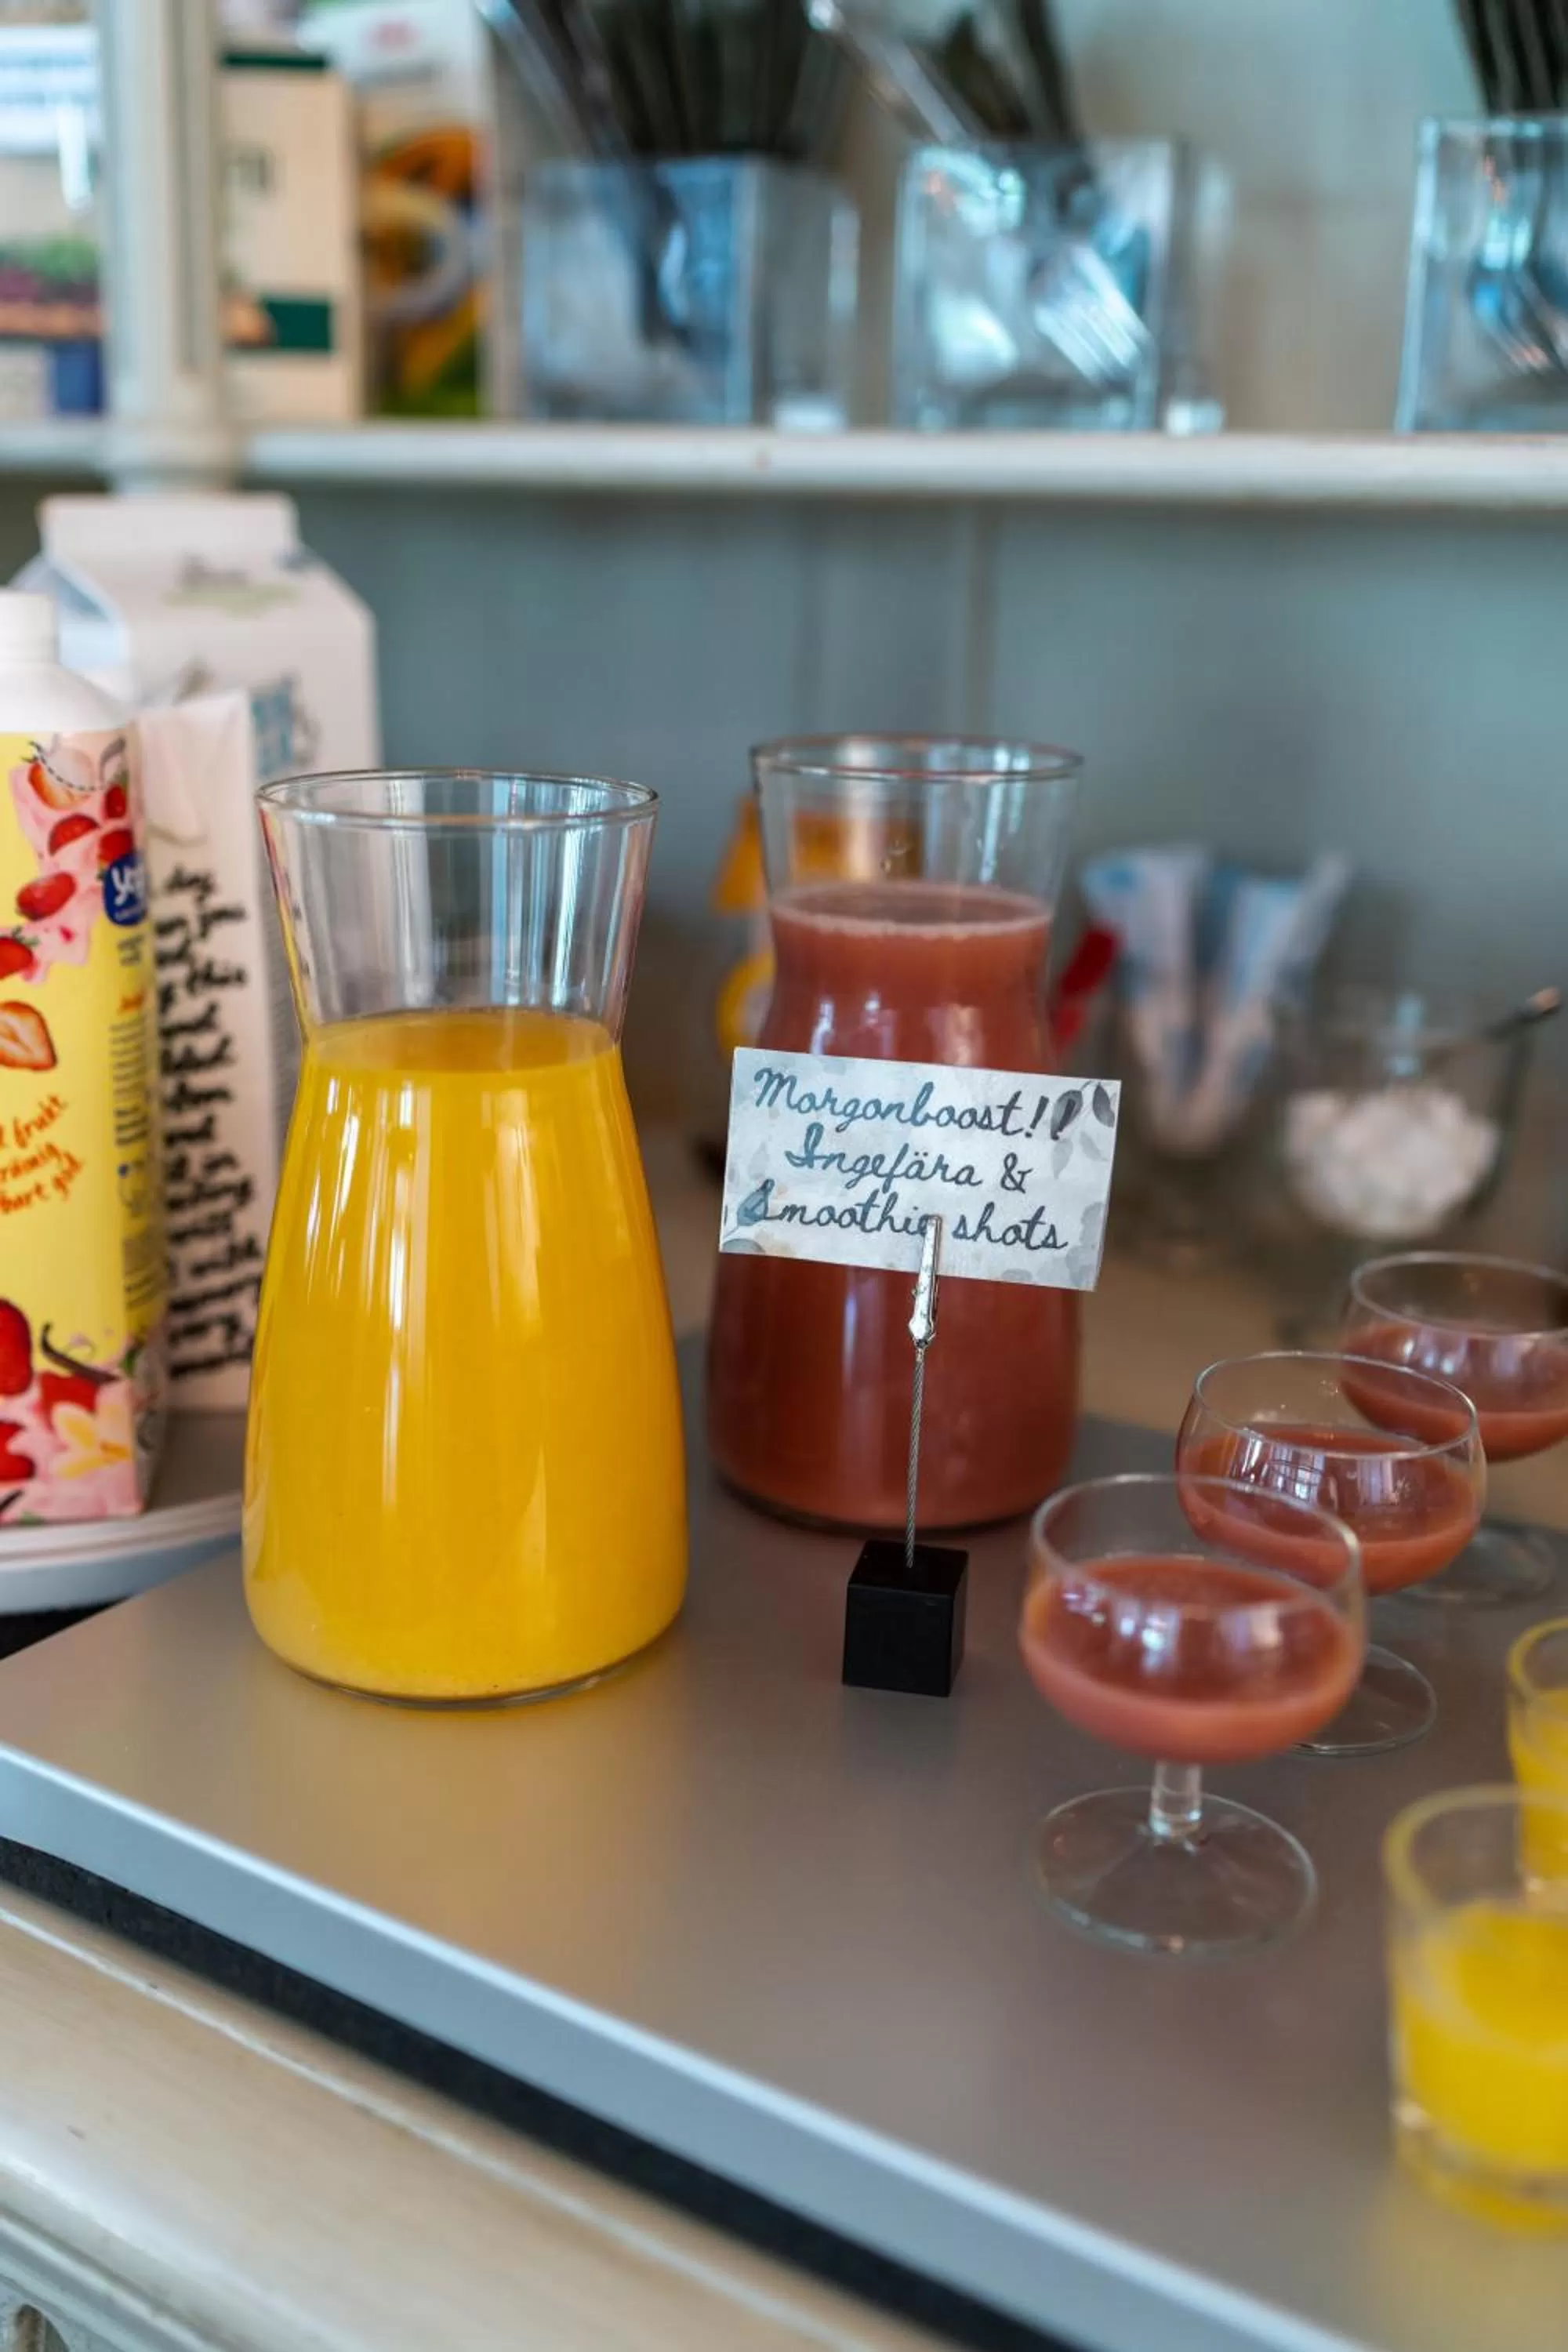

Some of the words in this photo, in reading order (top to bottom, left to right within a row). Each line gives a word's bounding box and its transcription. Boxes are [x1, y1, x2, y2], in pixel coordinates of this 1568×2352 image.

[753, 1067, 1076, 1141] Morgonboost!!
[785, 1122, 982, 1193] Ingefära
[1000, 1152, 1033, 1193] &
[953, 1200, 1069, 1251] shots
